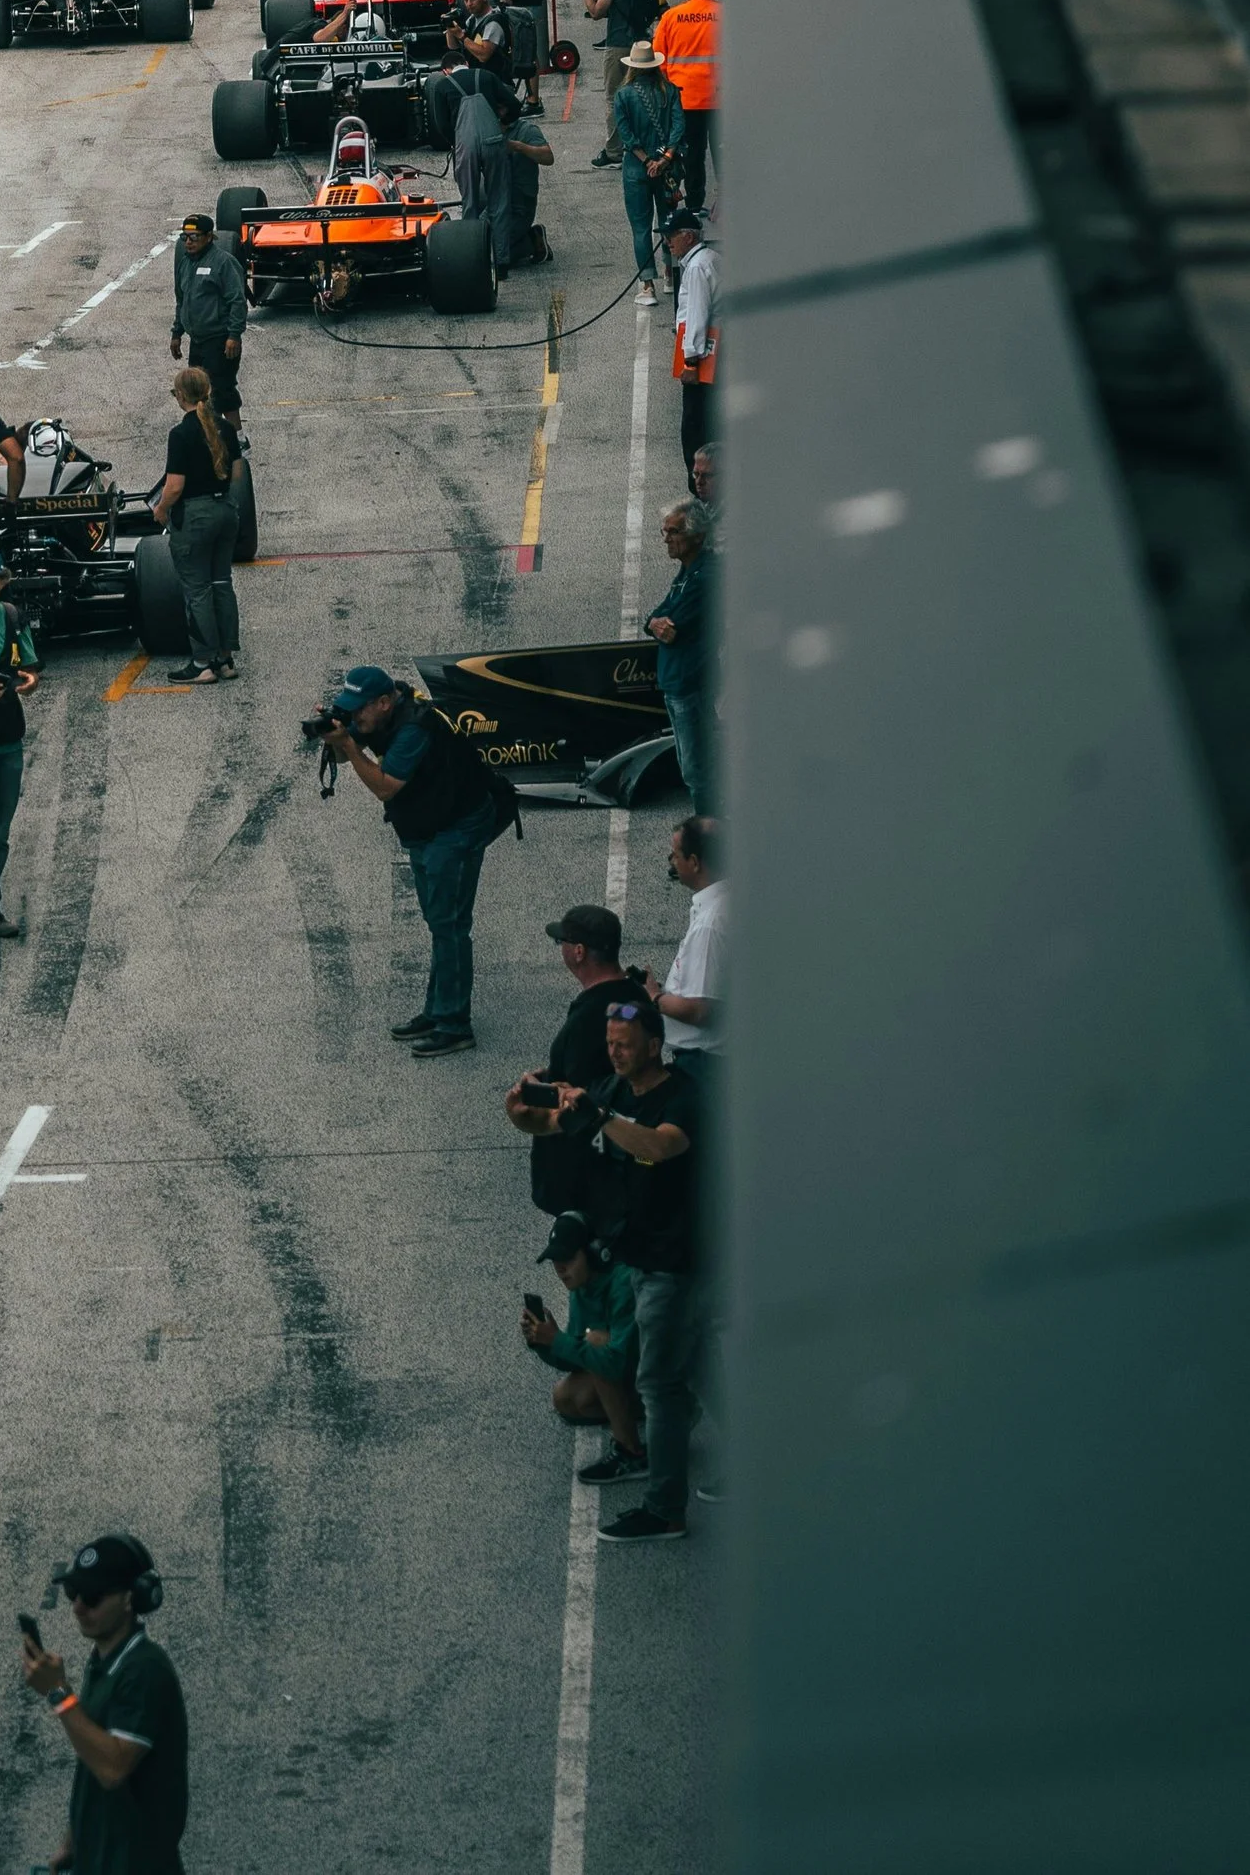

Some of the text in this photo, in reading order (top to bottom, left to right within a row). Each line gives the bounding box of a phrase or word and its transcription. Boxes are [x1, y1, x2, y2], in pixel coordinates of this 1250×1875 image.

[289, 45, 318, 55] CAFE
[336, 43, 395, 53] COLOMBIA
[35, 494, 98, 511] Special
